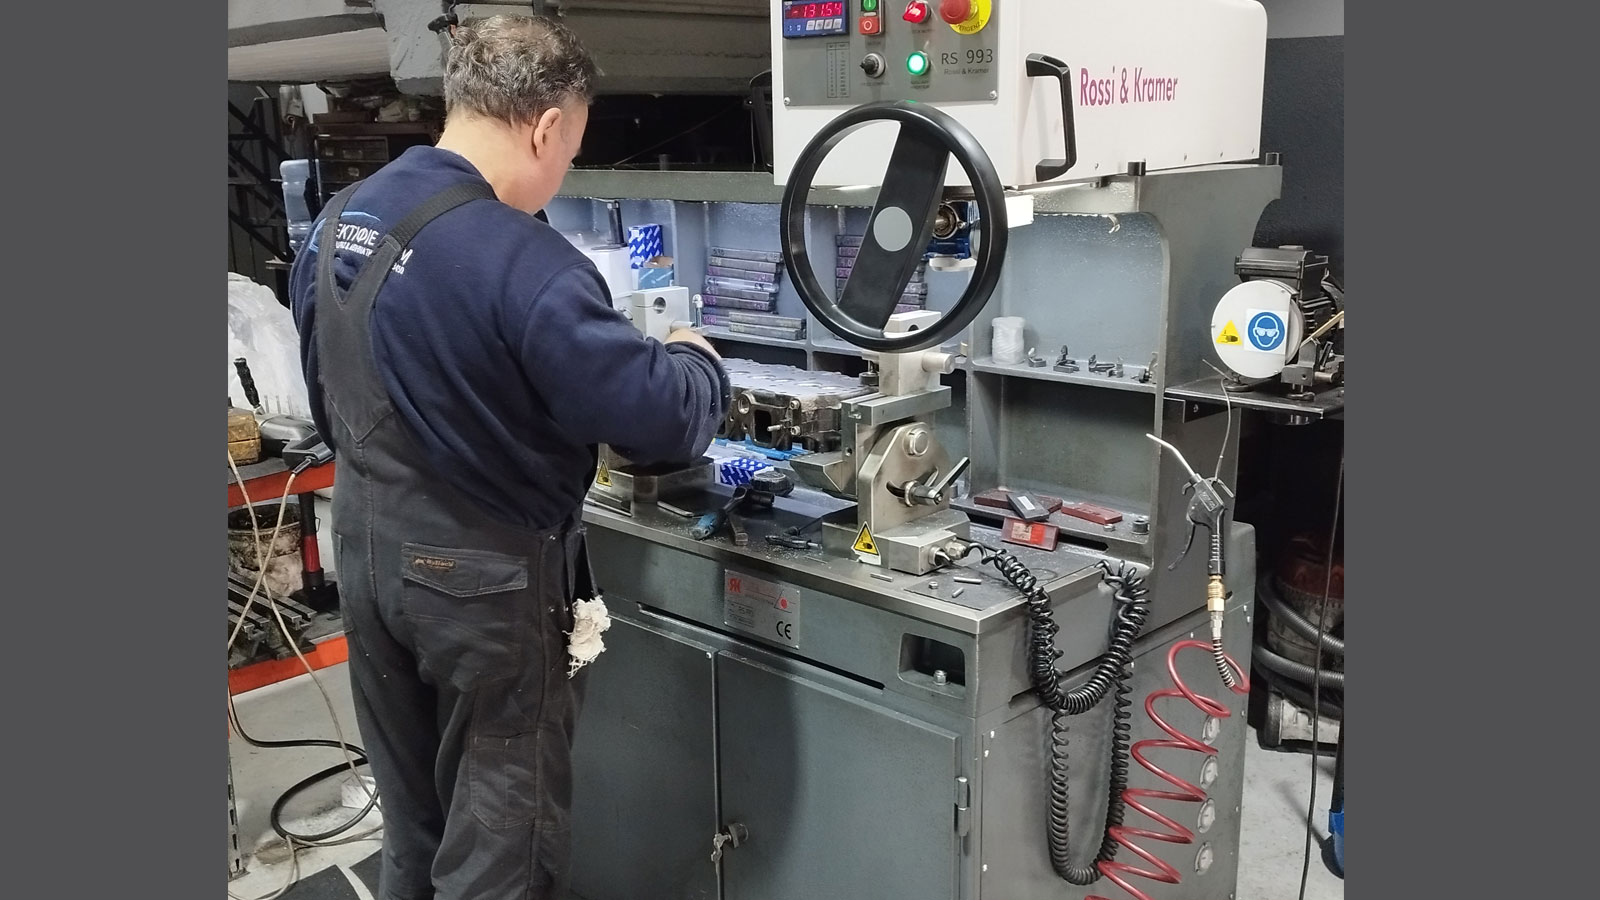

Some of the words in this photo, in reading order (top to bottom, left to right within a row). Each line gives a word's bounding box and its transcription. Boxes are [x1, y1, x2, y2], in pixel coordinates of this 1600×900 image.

[941, 52, 959, 65] RS
[966, 48, 994, 64] 993
[1080, 65, 1115, 106] Rossi
[1119, 67, 1129, 105] &
[1133, 66, 1178, 103] Kramer
[776, 620, 792, 640] CE
